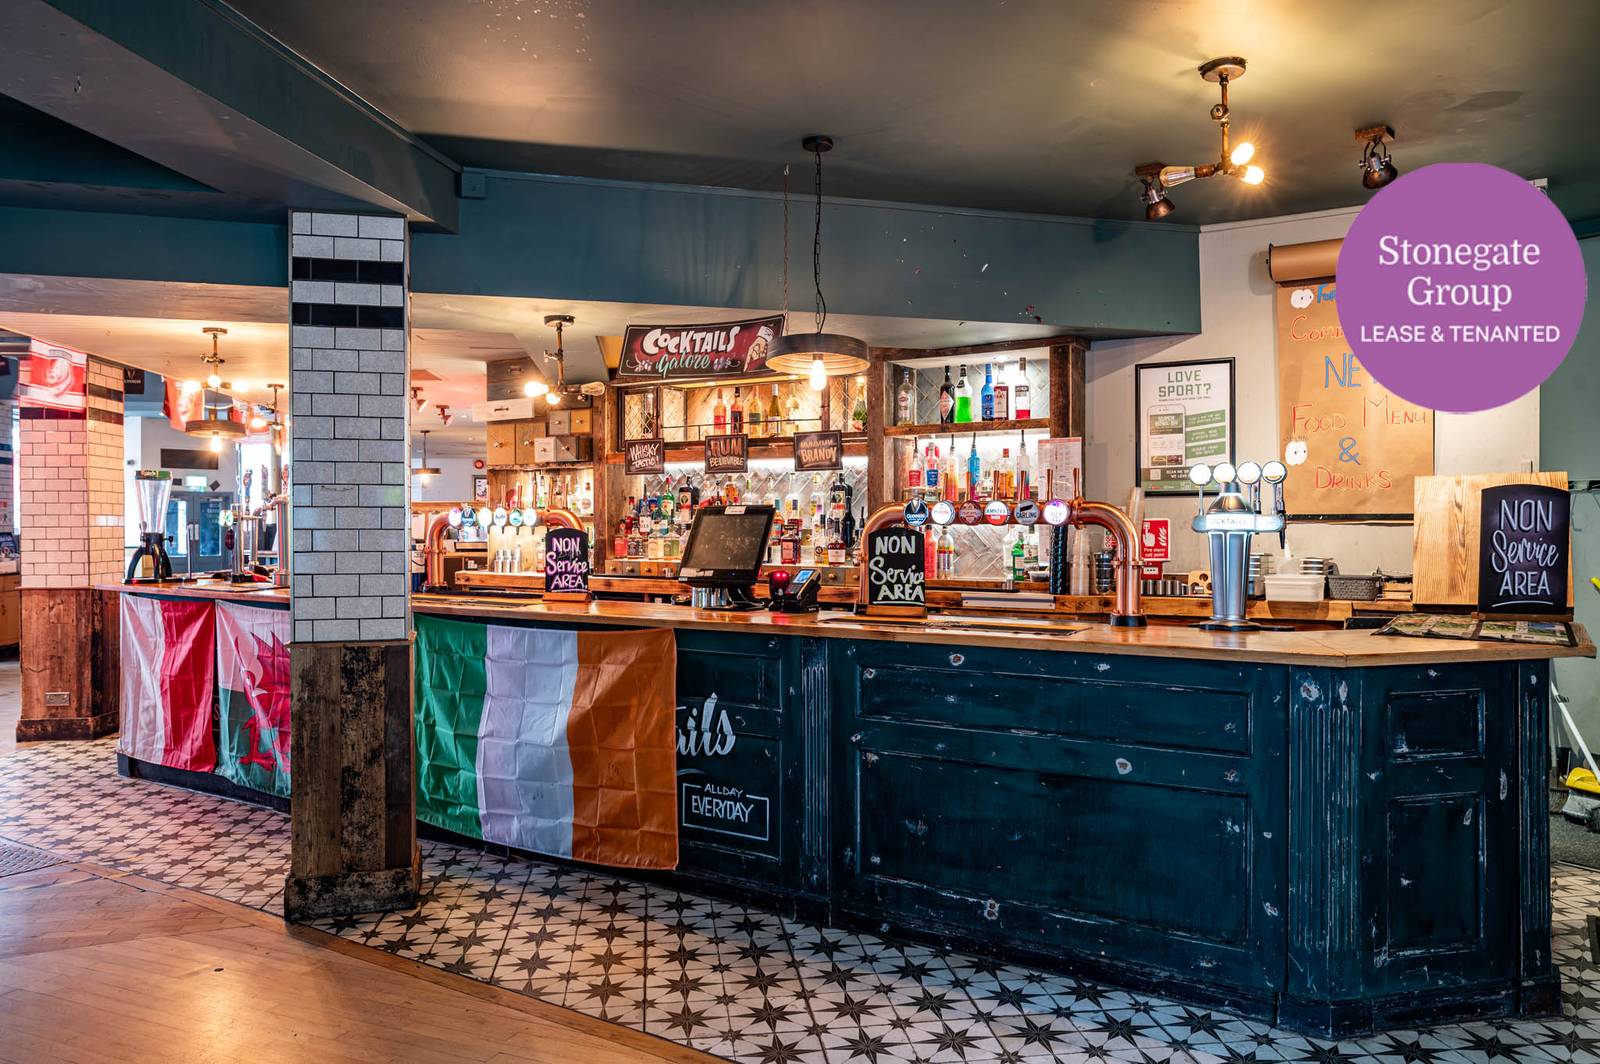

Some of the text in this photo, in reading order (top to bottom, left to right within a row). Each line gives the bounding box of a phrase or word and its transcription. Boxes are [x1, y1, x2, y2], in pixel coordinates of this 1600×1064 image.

[642, 326, 741, 355] COCKTAILS
[656, 351, 711, 378] Galore
[1168, 370, 1202, 383] LOVE
[1324, 351, 1381, 389] NE
[1158, 383, 1212, 398] SPORT?
[629, 443, 659, 461] WHISKY
[710, 438, 742, 457] RUM
[800, 446, 837, 463] BRANDY
[1338, 437, 1361, 465] &
[1500, 498, 1552, 532] NON
[552, 537, 580, 555] NON
[875, 535, 916, 556] NON
[1491, 530, 1559, 573] Service
[546, 552, 588, 575] Service
[869, 556, 925, 585] Service
[877, 584, 924, 602] AREA
[1499, 570, 1551, 596] AREA
[691, 795, 754, 823] EVERYDAY
